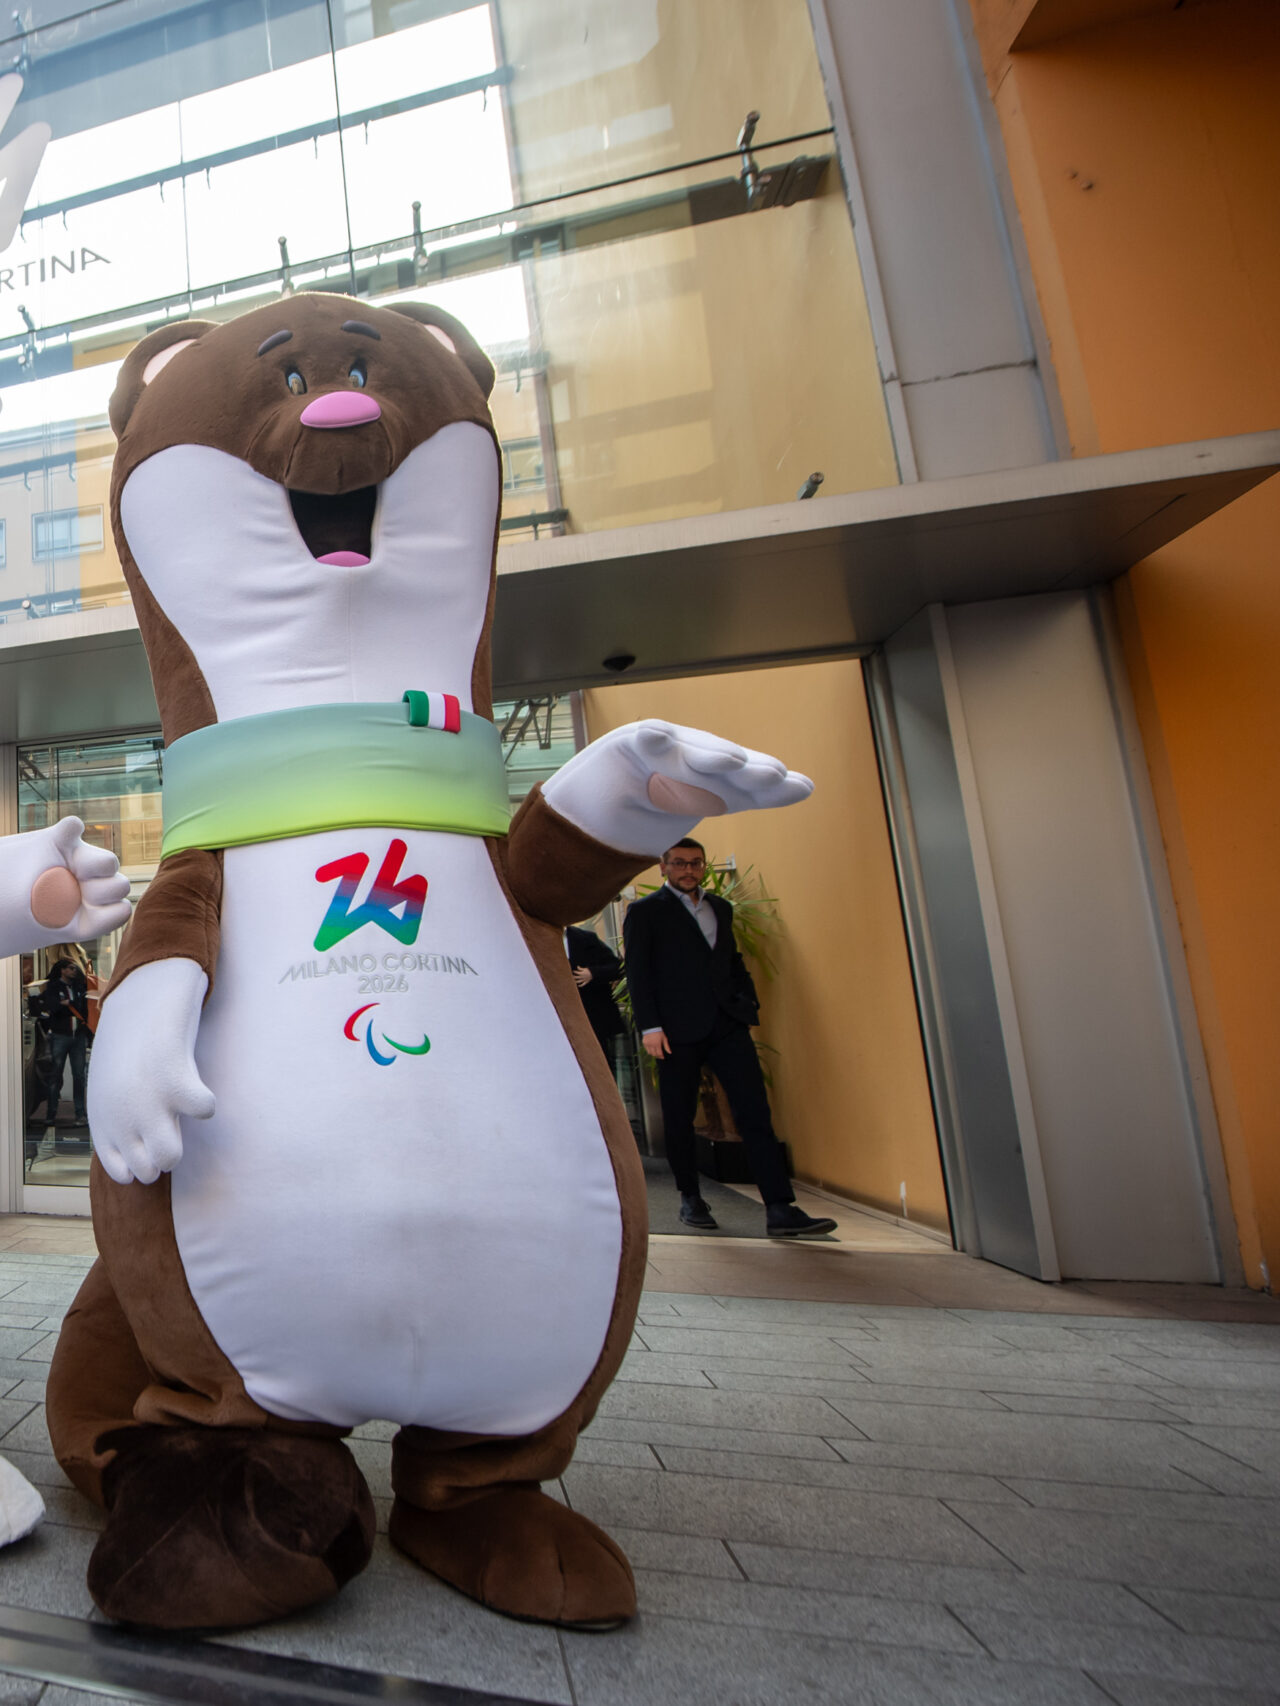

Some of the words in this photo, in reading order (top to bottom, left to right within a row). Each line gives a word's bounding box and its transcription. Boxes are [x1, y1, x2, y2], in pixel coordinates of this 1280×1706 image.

[278, 953, 378, 985] MILANO
[381, 952, 480, 977] CORTINA
[357, 974, 410, 995] 2026
